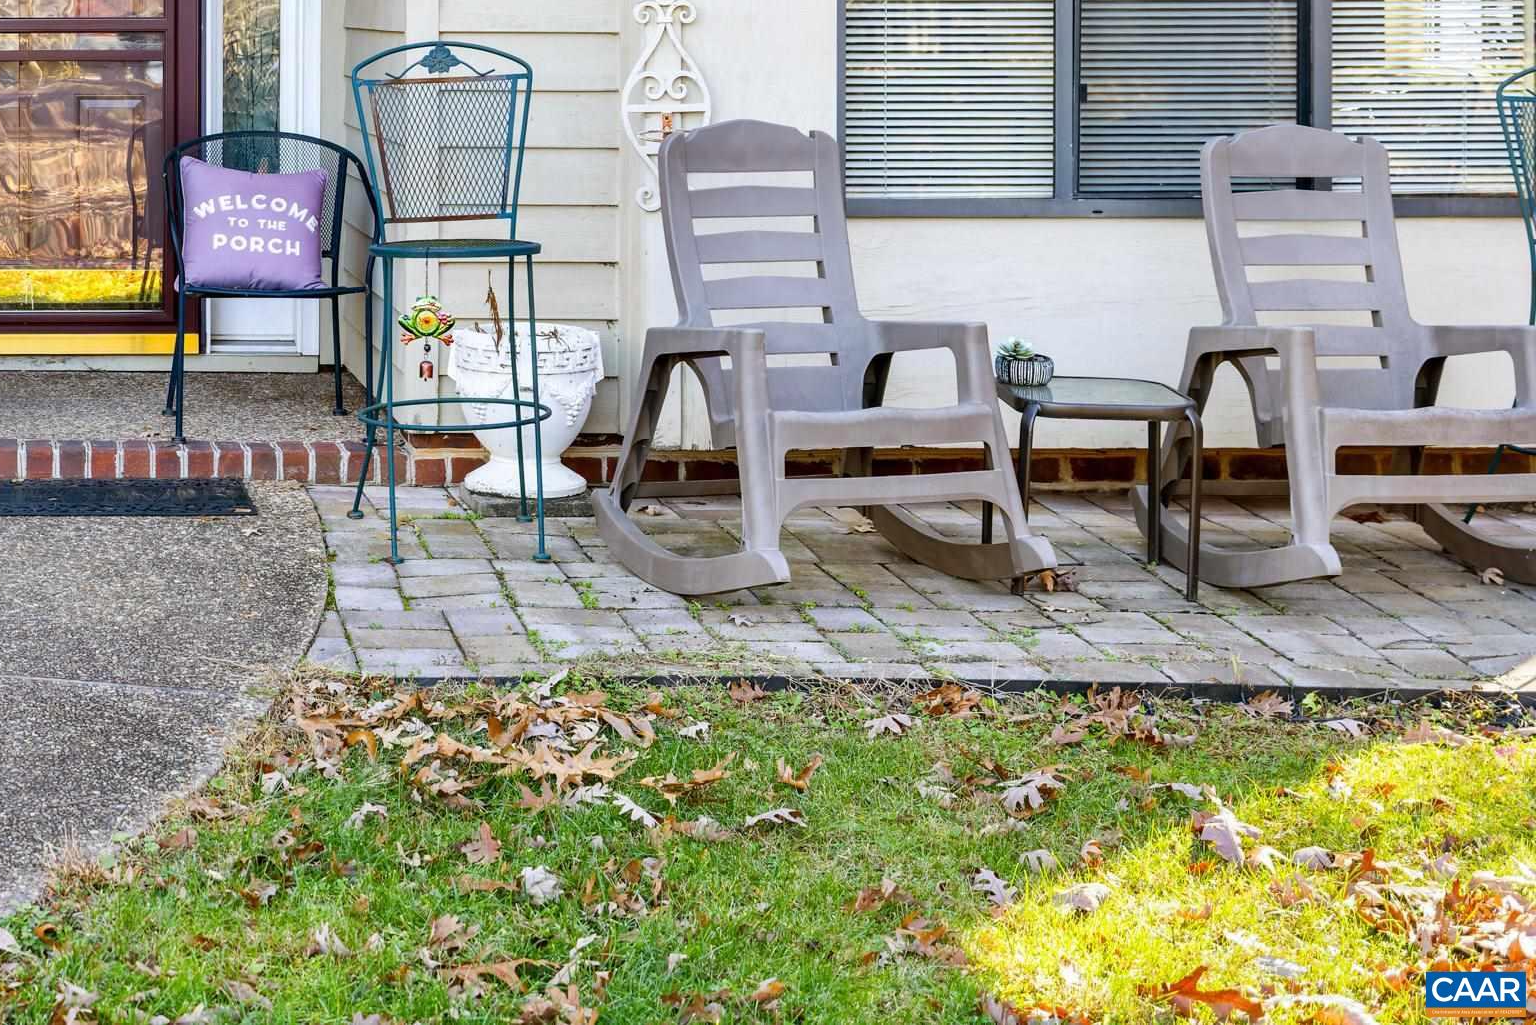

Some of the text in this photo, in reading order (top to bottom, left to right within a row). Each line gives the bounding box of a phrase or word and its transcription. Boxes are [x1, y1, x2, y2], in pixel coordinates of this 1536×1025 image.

[193, 194, 319, 232] WELCOME
[228, 217, 287, 231] TO THE
[213, 234, 300, 256] PORCH
